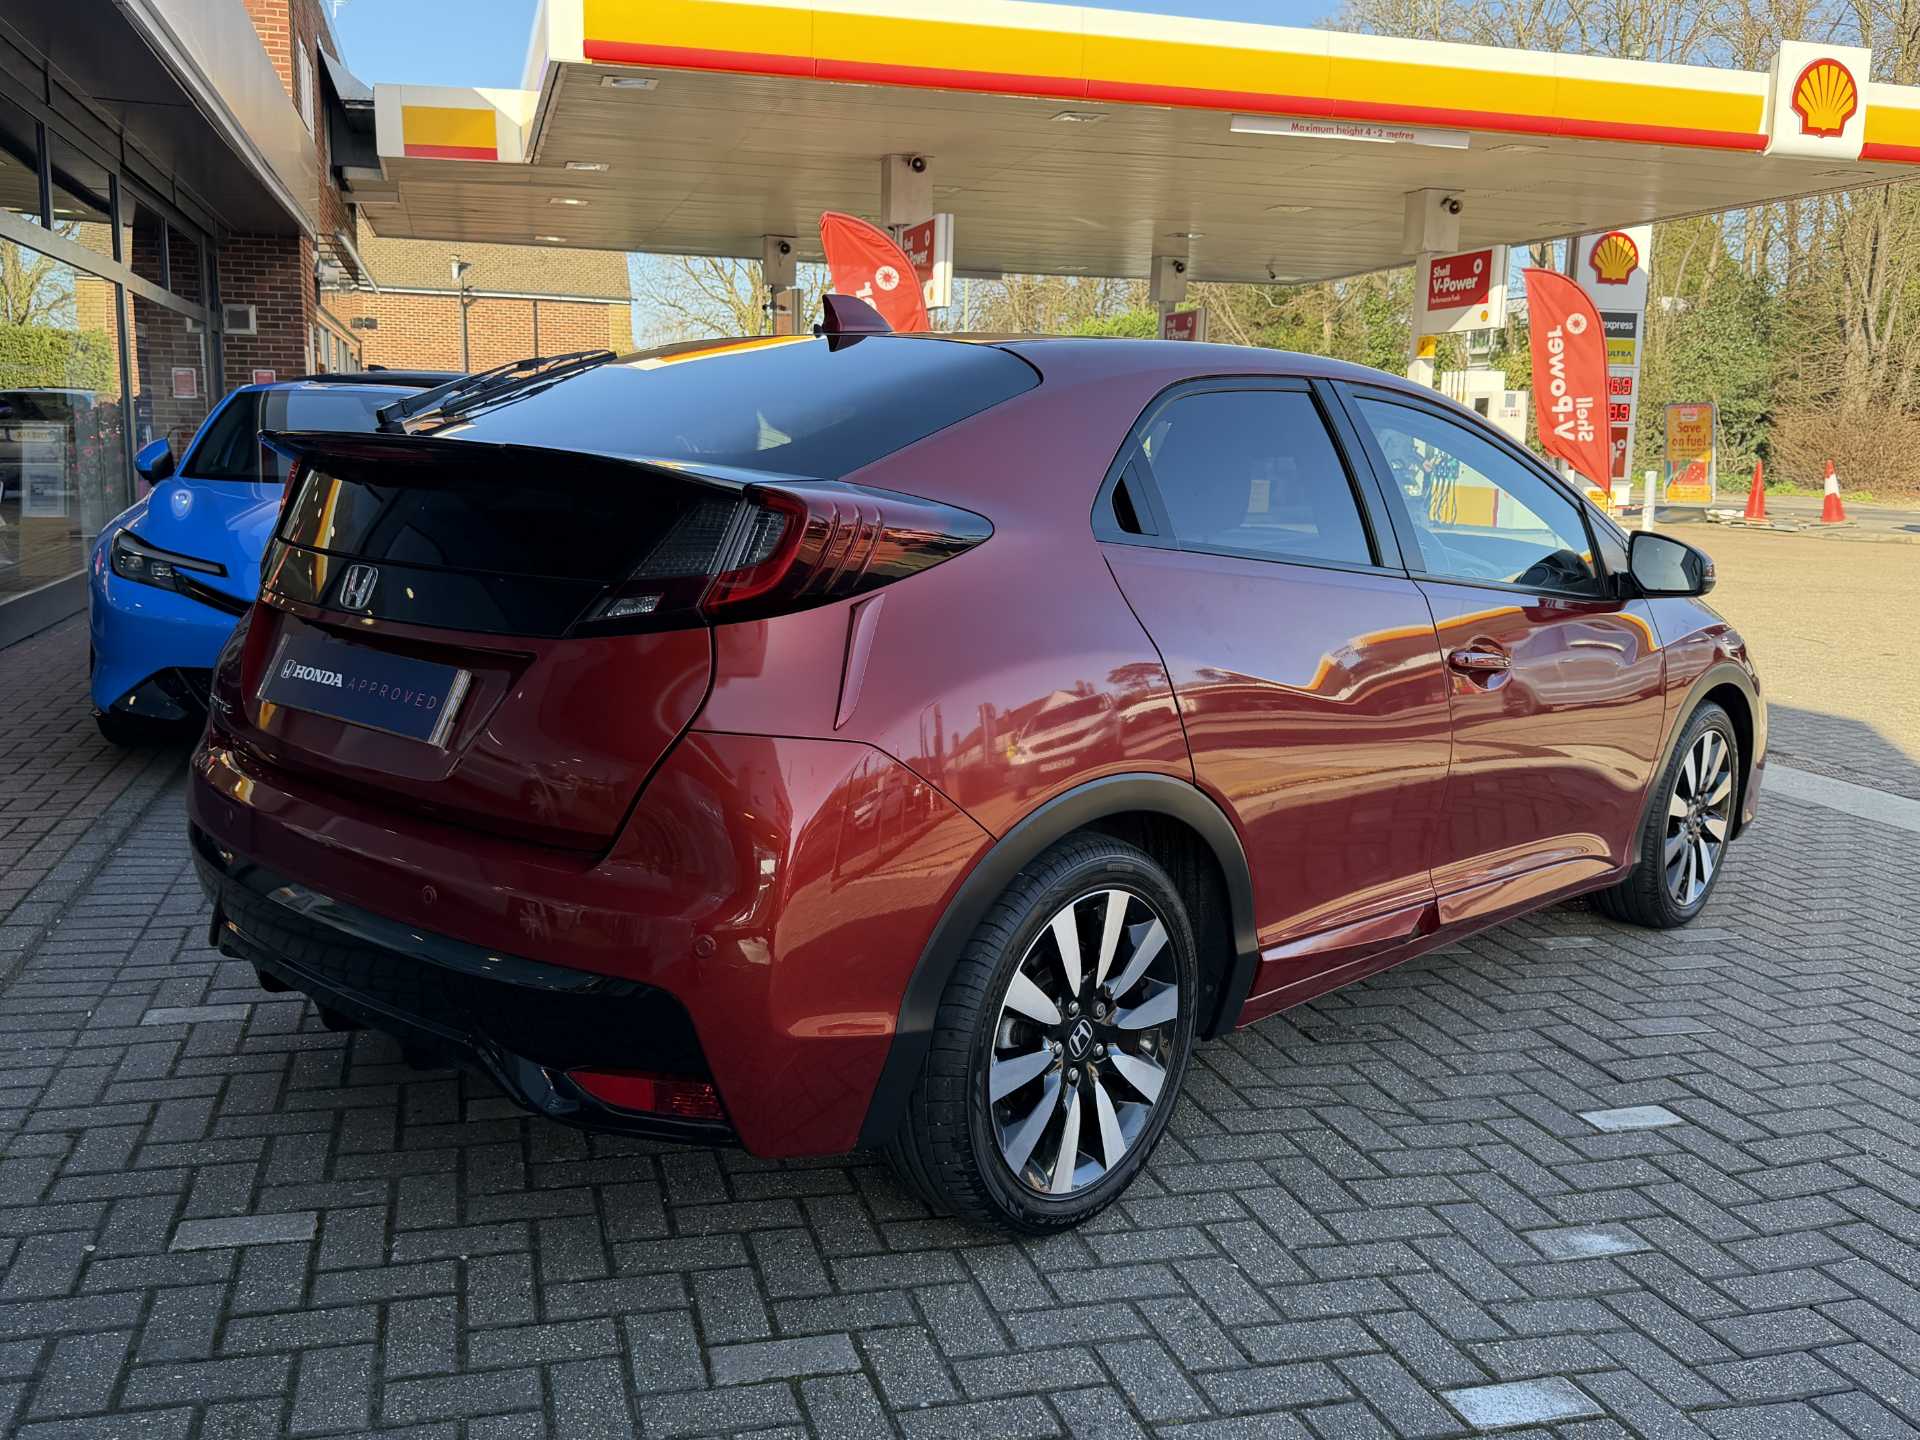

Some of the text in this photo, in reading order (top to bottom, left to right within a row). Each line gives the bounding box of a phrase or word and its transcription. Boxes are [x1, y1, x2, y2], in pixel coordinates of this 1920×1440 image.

[1291, 122, 1335, 134] Maximum
[1335, 124, 1364, 137] height
[1386, 129, 1415, 140] metres
[1433, 264, 1451, 277] Shell
[1433, 276, 1478, 293] V-Power
[1677, 422, 1702, 433] Save
[1672, 435, 1706, 448] on fuel
[293, 665, 438, 710] HONDA APPROVED
